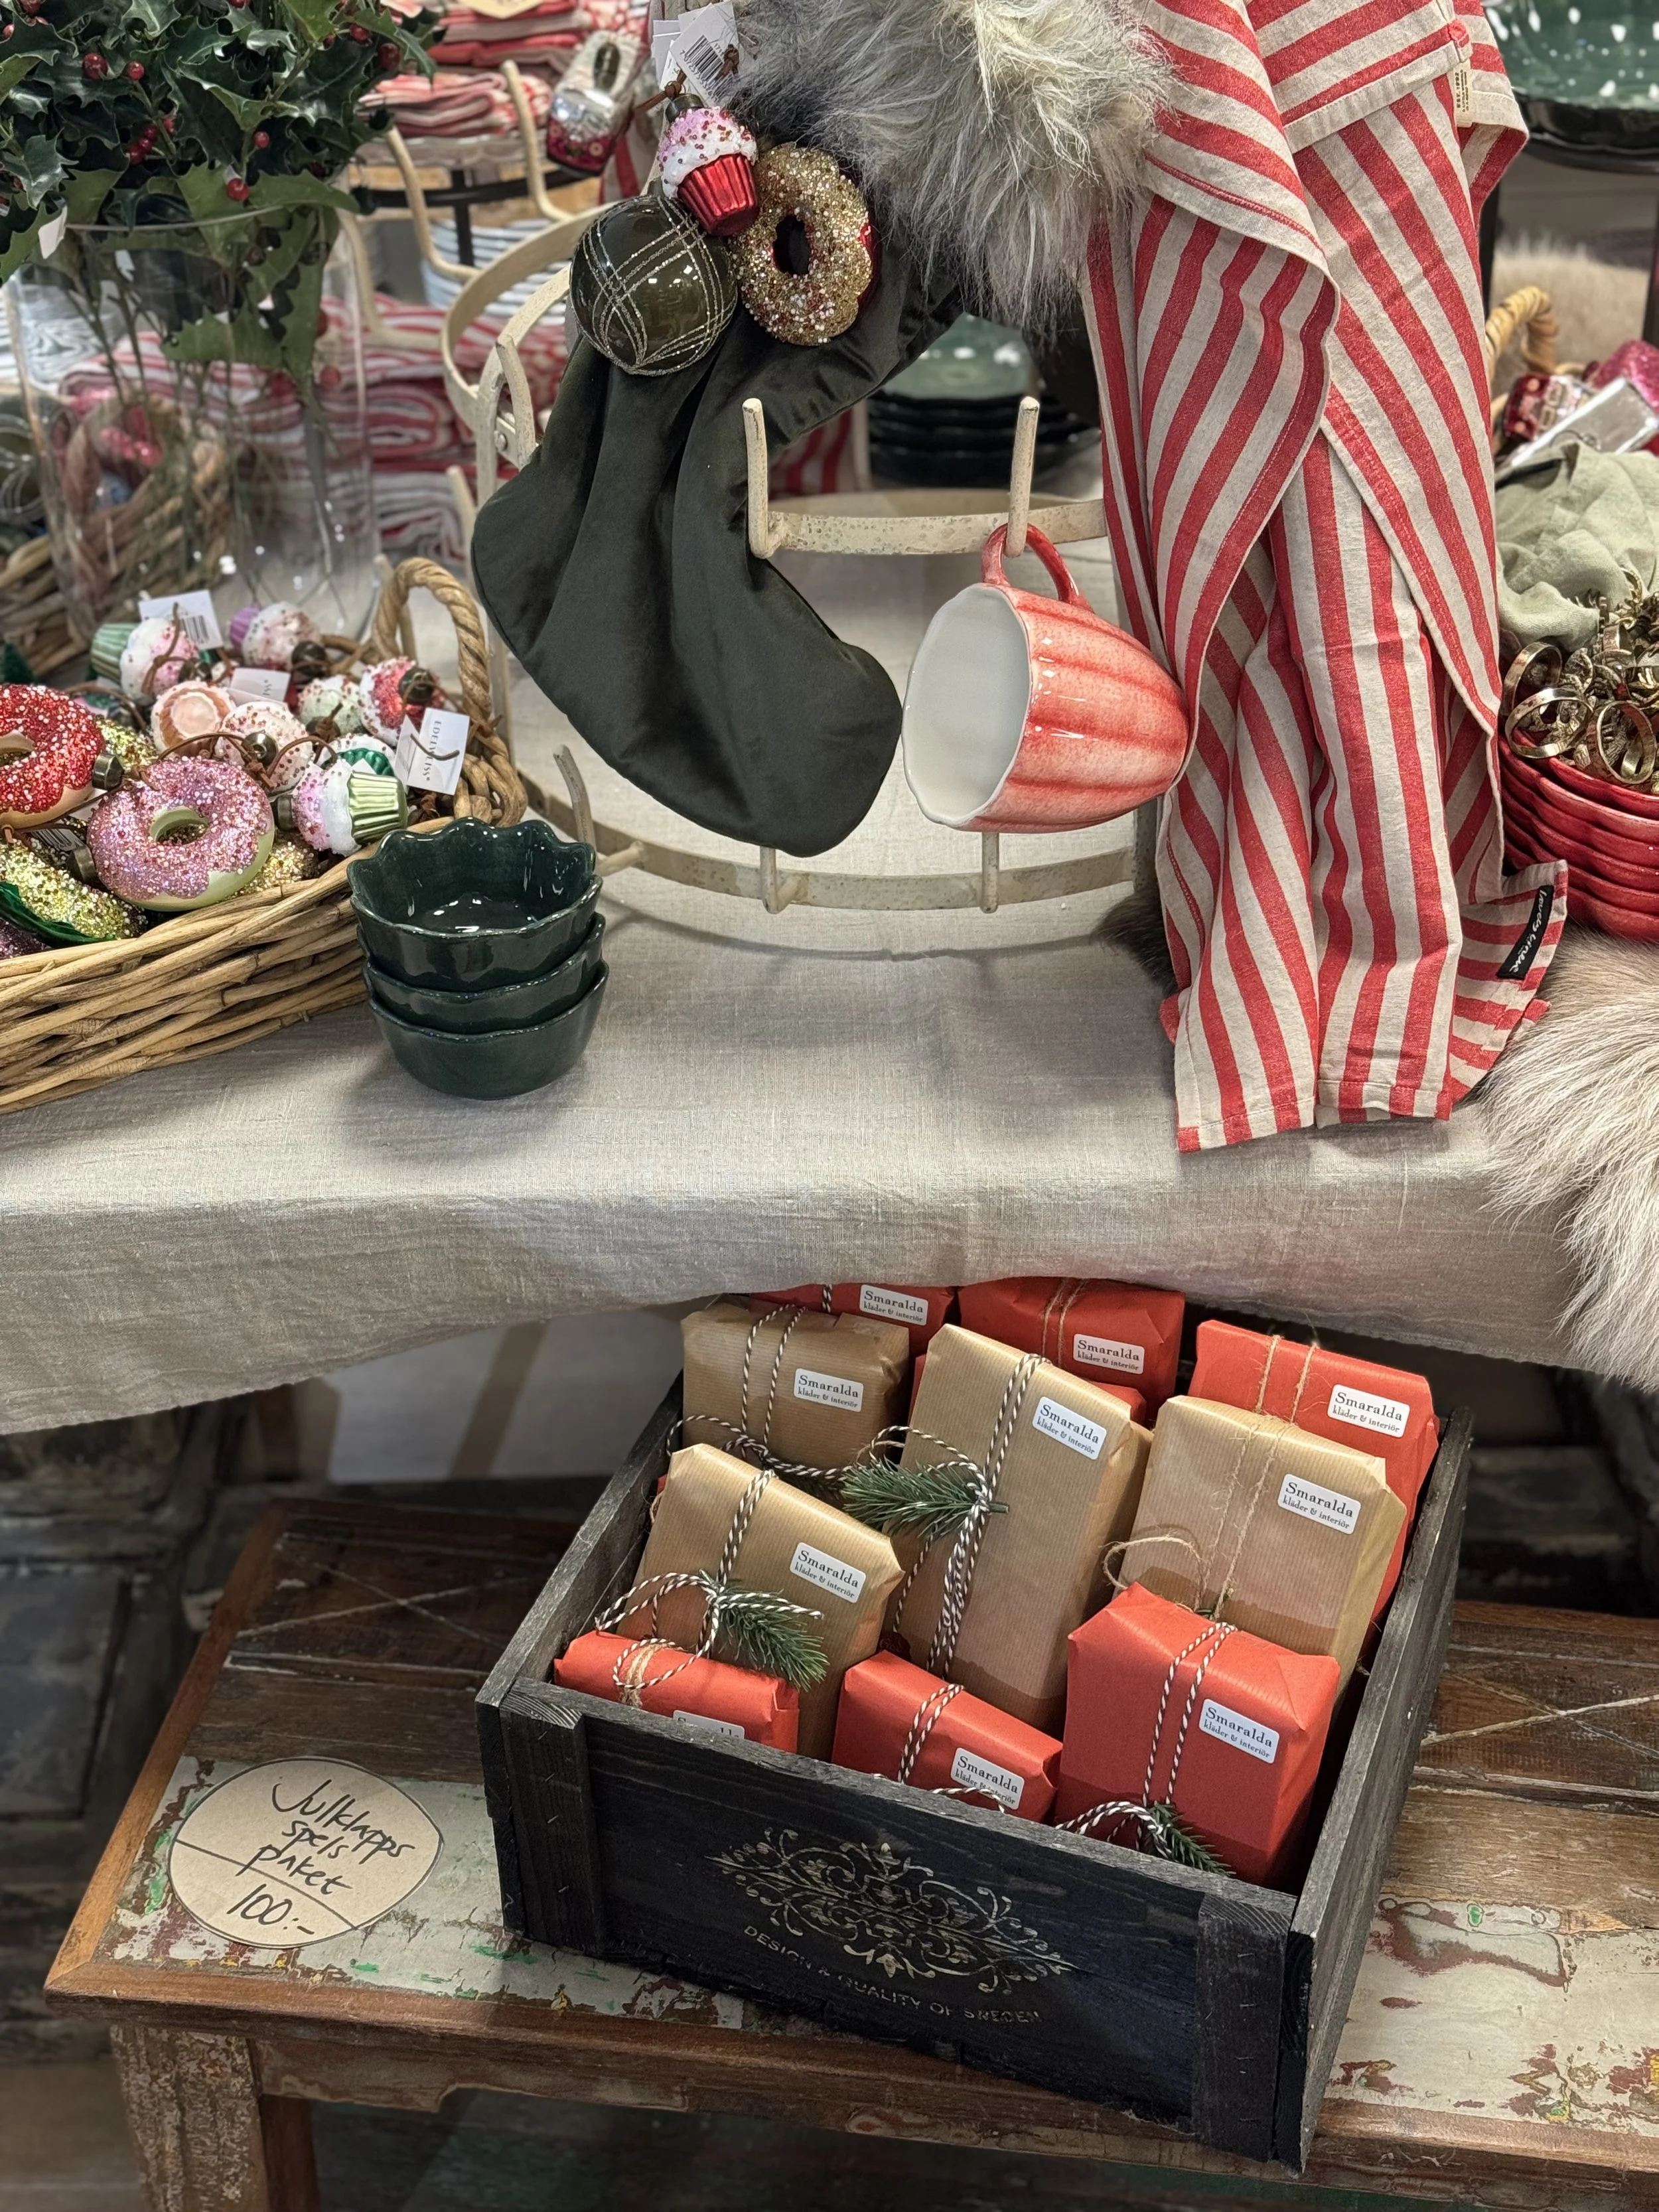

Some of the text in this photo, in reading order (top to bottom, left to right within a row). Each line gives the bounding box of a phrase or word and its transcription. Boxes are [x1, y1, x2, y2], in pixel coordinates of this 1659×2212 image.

[864, 1290, 923, 1313] Smaralda
[864, 1301, 886, 1313] kläder
[896, 1311, 923, 1322] interiör
[1078, 1339, 1139, 1361] Smaralda
[1078, 1350, 1100, 1363] kläder
[1111, 1360, 1139, 1370] interiör
[798, 1374, 858, 1397] Smaralda
[798, 1386, 820, 1398] kläder
[831, 1396, 858, 1408] interiör
[1040, 1404, 1099, 1443] Smaralda
[1333, 1404, 1358, 1420] kläder
[1368, 1418, 1400, 1432] interiör
[1335, 1392, 1402, 1421] Smaralda
[1037, 1416, 1058, 1435] kläder
[1068, 1436, 1095, 1454] interiör
[1283, 1495, 1309, 1512] kläder
[1319, 1511, 1350, 1529] interiör
[1285, 1482, 1353, 1518] Smaralda
[794, 1562, 818, 1580] kläder
[827, 1580, 855, 1598] interiör
[798, 1550, 858, 1588] Smaralda
[1204, 1719, 1229, 1738] kläder
[1240, 1738, 1270, 1758] interiör
[1206, 1707, 1272, 1747] Smaralda
[955, 1768, 977, 1787] kläder
[958, 1755, 1018, 1794] Smaralda
[278, 1820, 349, 1859] spels
[226, 1883, 315, 1935] 100:-
